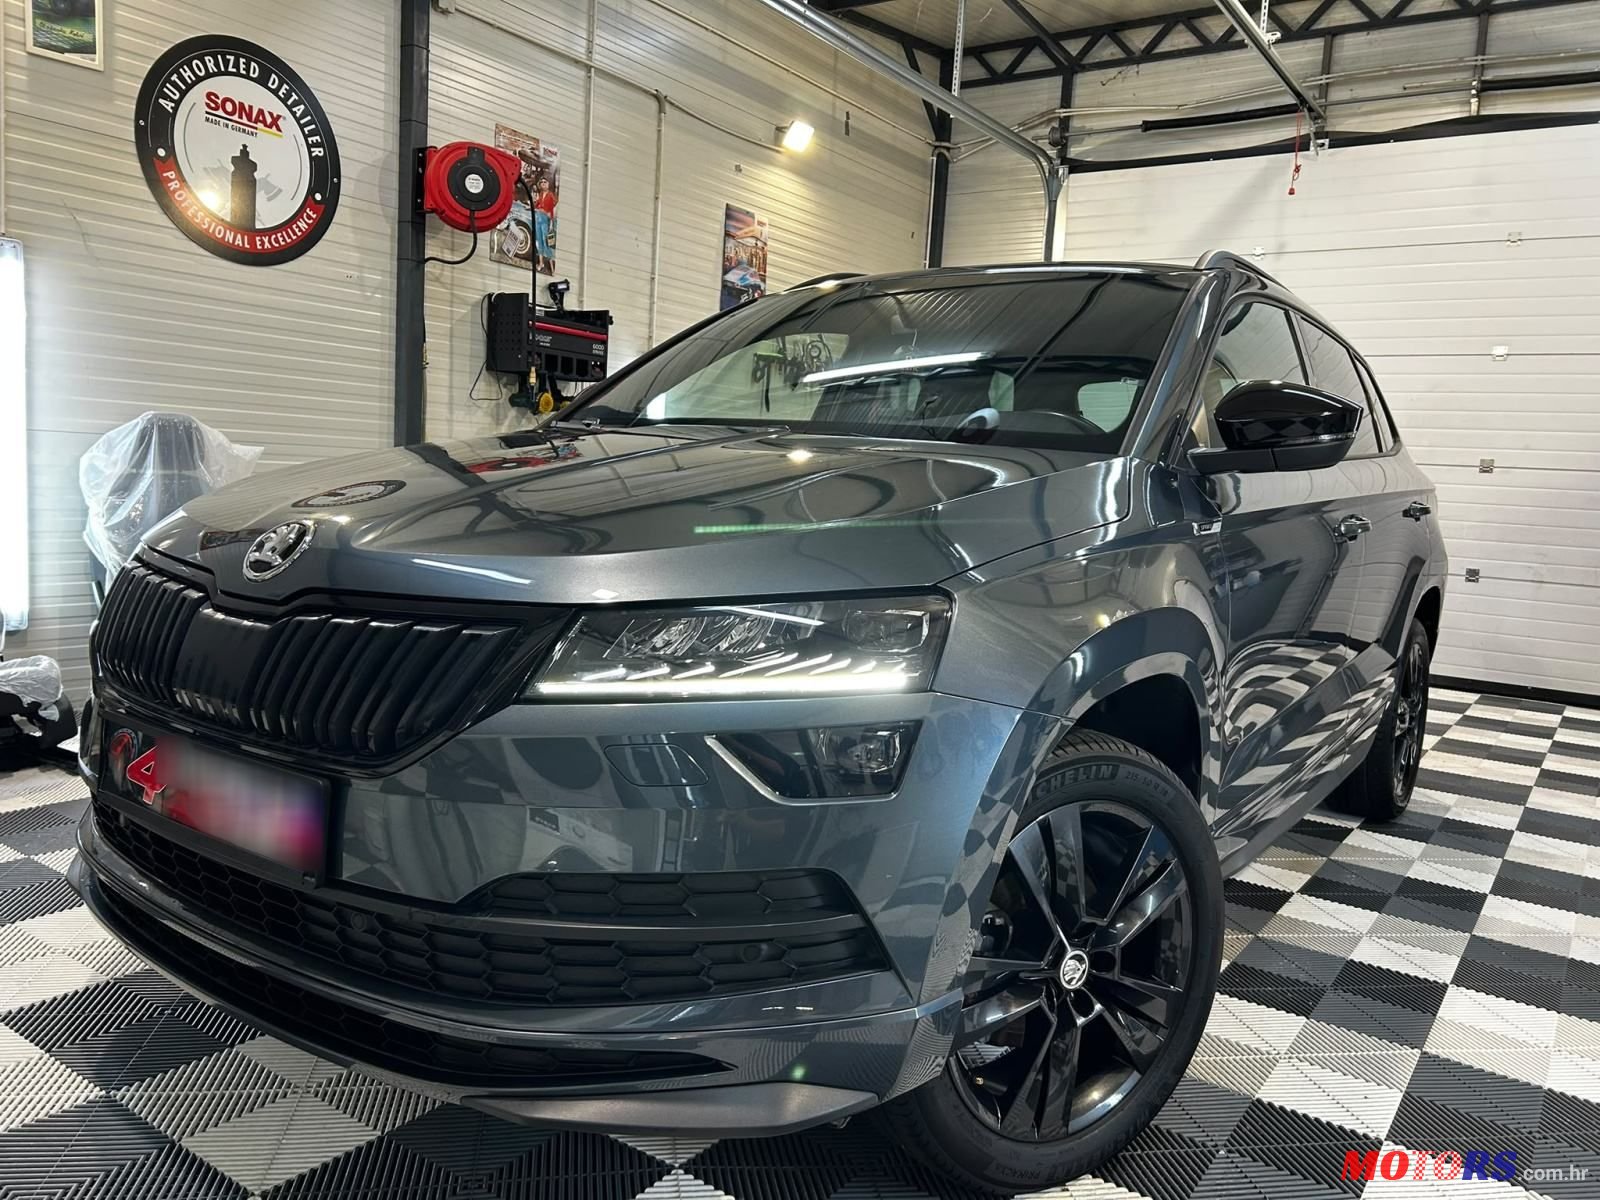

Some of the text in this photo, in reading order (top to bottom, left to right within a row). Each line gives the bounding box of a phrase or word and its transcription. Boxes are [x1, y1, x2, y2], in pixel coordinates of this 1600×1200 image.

[158, 54, 324, 157] AUTHORIZED DETAILER
[204, 91, 283, 132] SONAX
[204, 116, 258, 138] MADE IN GERMANY
[162, 170, 317, 249] PROFESSIONAL EXCELLENCE
[1034, 765, 1113, 799] CHELIN
